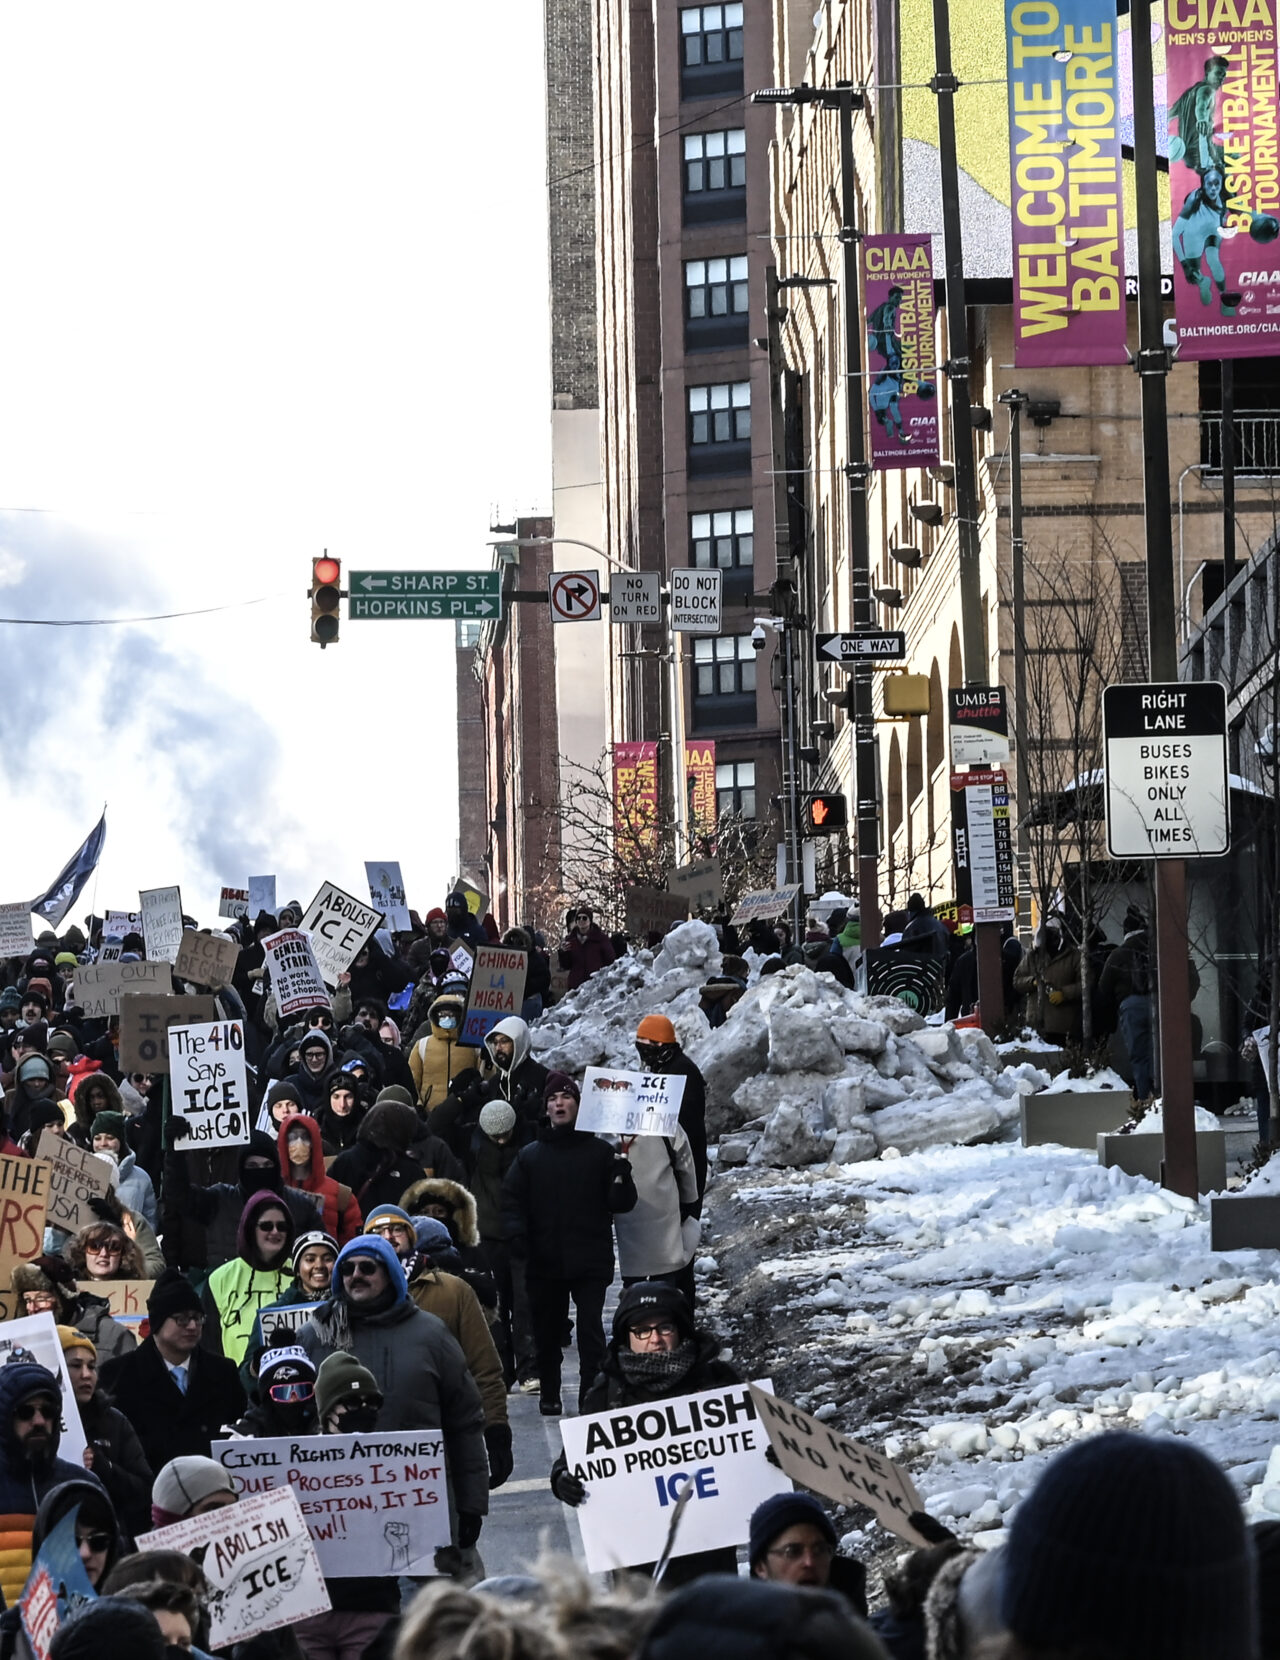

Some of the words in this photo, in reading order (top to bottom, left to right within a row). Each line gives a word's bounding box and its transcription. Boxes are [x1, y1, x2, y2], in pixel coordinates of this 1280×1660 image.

[1166, 0, 1272, 30] CIAA
[1011, 1, 1060, 58] TO
[1168, 32, 1204, 45] MEN'S
[1218, 29, 1274, 43] WOMEN'S
[1223, 44, 1253, 233] BASKETBALL
[1064, 22, 1119, 312] BALTIMORE
[1015, 80, 1069, 338] WELCOME
[865, 247, 930, 271] CIAA
[900, 280, 918, 395] BASKETBALL
[917, 280, 935, 382] TOURNAMENT
[391, 575, 457, 590] SHARP
[466, 575, 490, 590] ST.
[627, 579, 643, 588] NO
[675, 577, 689, 590] DO
[697, 577, 718, 590] NOT
[622, 593, 649, 602] TURN
[675, 596, 716, 609] BLOCK
[356, 600, 444, 616] HOPKINS
[613, 606, 628, 615] ON
[637, 606, 657, 615] RED
[674, 614, 718, 624] INTERSECTION
[840, 640, 866, 653] ONE
[870, 639, 896, 652] WAY
[955, 693, 987, 706] UMB
[1142, 694, 1187, 709] RIGHT
[957, 706, 1001, 718] shuttle
[1144, 715, 1186, 729] LANE
[1140, 744, 1192, 758] BUSES
[1144, 765, 1189, 779] BIKES
[1147, 786, 1187, 800] ONLY
[1154, 807, 1183, 821] ALL
[1146, 828, 1192, 842] TIMES
[999, 875, 1011, 883] 210
[1000, 886, 1012, 894] 215
[320, 891, 376, 929] ABOLISH
[309, 910, 363, 951] ICE
[103, 948, 119, 960] END
[190, 936, 228, 963] ICE
[478, 952, 525, 970] CHINGA
[78, 969, 105, 985] ICE
[120, 964, 160, 979] OUT
[289, 971, 309, 980] work
[490, 975, 505, 989] LA
[474, 992, 515, 1010] MIGRA
[465, 1018, 486, 1037] ICE
[170, 1030, 205, 1054] The
[208, 1023, 242, 1051] 410
[187, 1056, 226, 1087] Says
[641, 1077, 667, 1089] ICE
[184, 1081, 240, 1113] ICE
[637, 1093, 669, 1104] melts
[215, 1112, 249, 1141] GO!
[55, 1140, 96, 1175] ICE
[1, 1159, 48, 1196] THE
[586, 1390, 757, 1455] ABOLISH
[764, 1398, 812, 1436] NO
[827, 1432, 889, 1480] ICE
[574, 1457, 617, 1483] AND
[624, 1430, 757, 1474] PROSECUTE
[232, 1475, 276, 1495] DUE
[287, 1469, 364, 1493] PROCESS
[778, 1431, 828, 1470] NO
[839, 1464, 910, 1516] KKK
[655, 1466, 719, 1508] ICE
[214, 1517, 290, 1579] ABOLISH
[242, 1556, 292, 1600] ICE
